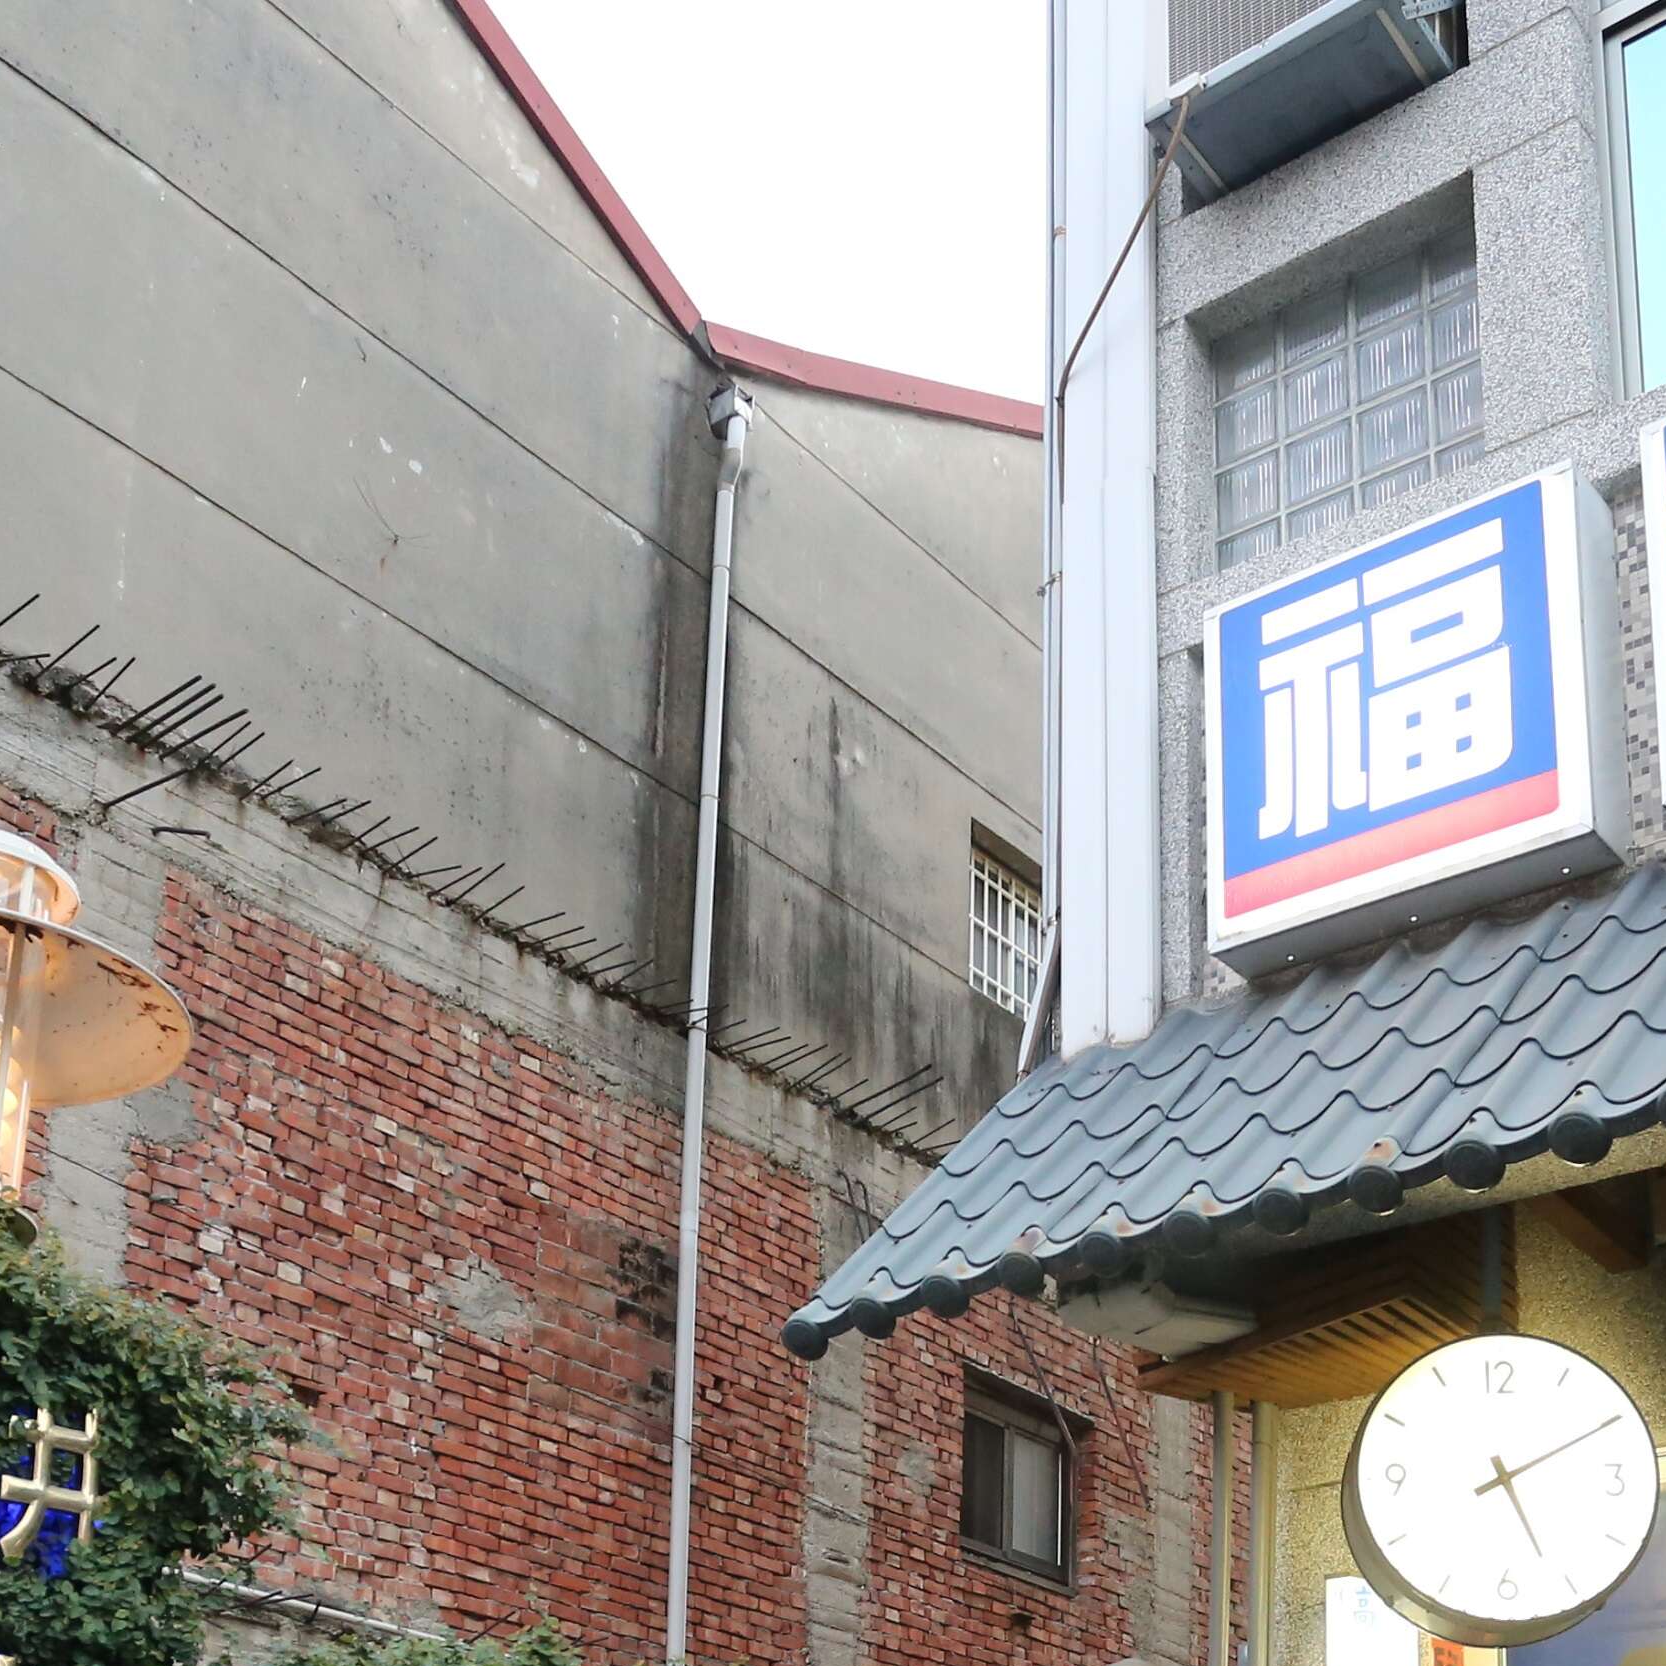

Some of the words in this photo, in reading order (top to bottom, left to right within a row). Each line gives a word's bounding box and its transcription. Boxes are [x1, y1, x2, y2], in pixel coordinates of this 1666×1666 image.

[1484, 1360, 1515, 1394] 12
[1385, 1463, 1407, 1496] 9
[1604, 1463, 1626, 1497] 3
[1497, 1567, 1519, 1601] 6
